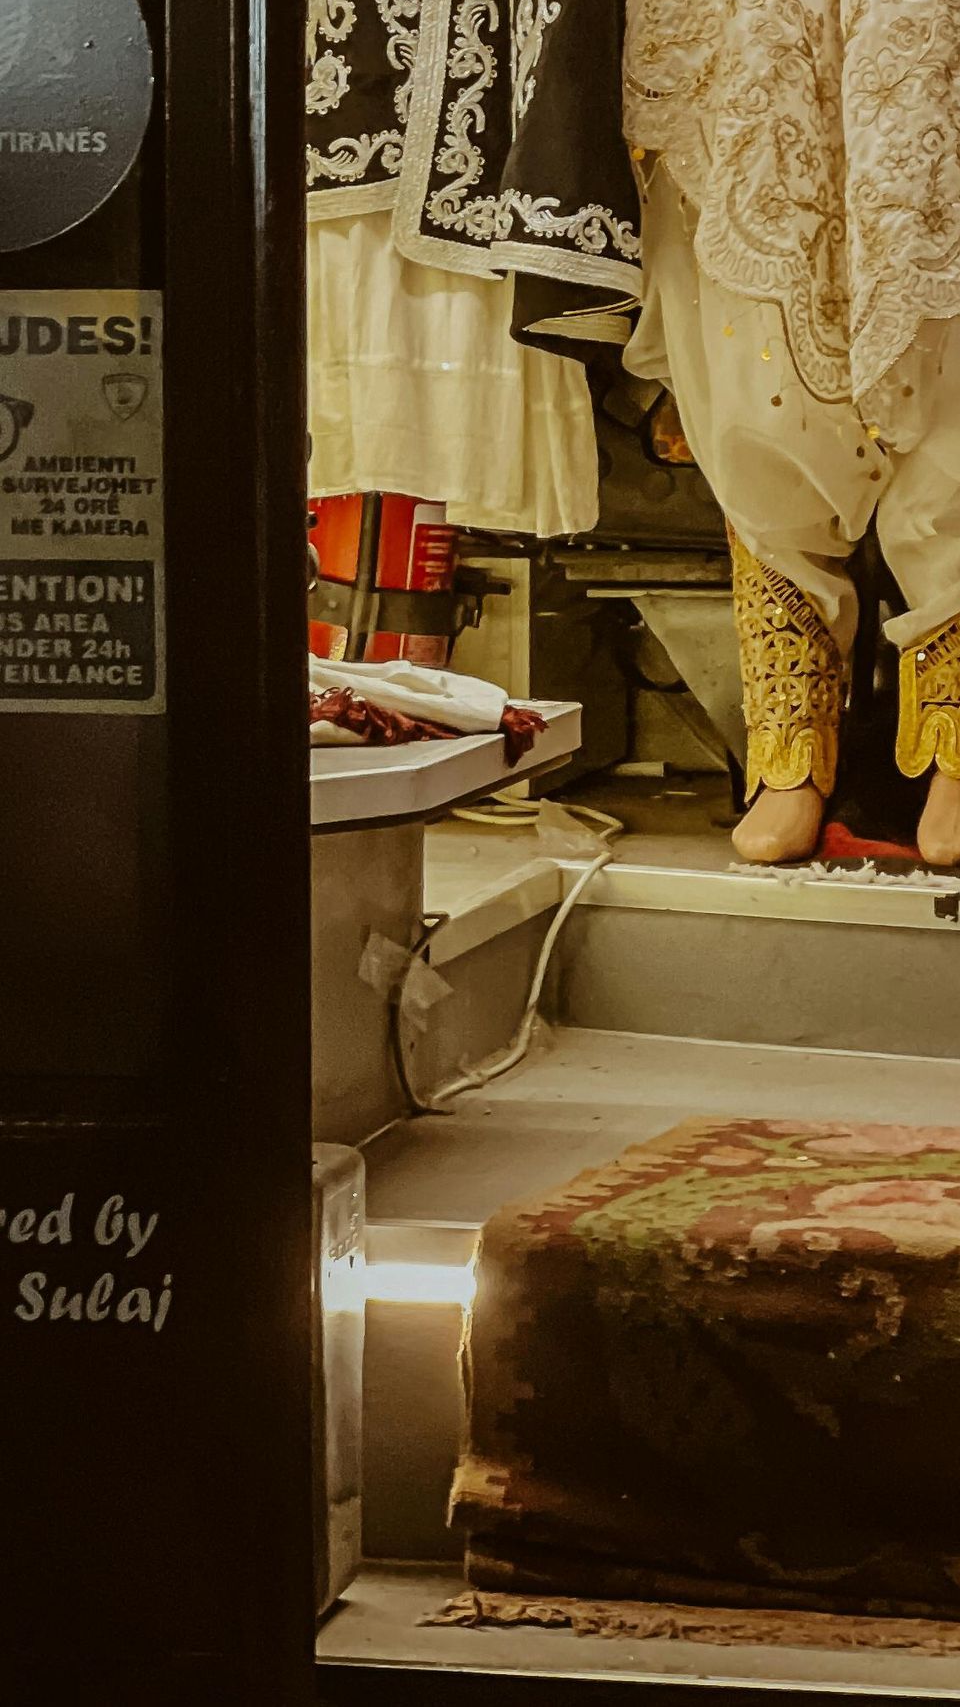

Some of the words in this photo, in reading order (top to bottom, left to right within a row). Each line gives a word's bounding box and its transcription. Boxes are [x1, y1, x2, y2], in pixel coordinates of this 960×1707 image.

[24, 456, 136, 473] AMBIENTI
[2, 477, 157, 494] SURVEJOMET
[40, 498, 65, 514] 24
[11, 519, 44, 535] ME
[52, 519, 149, 536] KAMERA
[34, 613, 110, 632] AREA
[82, 639, 131, 659] 24h
[94, 1194, 160, 1258] by
[14, 1271, 173, 1332] Sulaj
